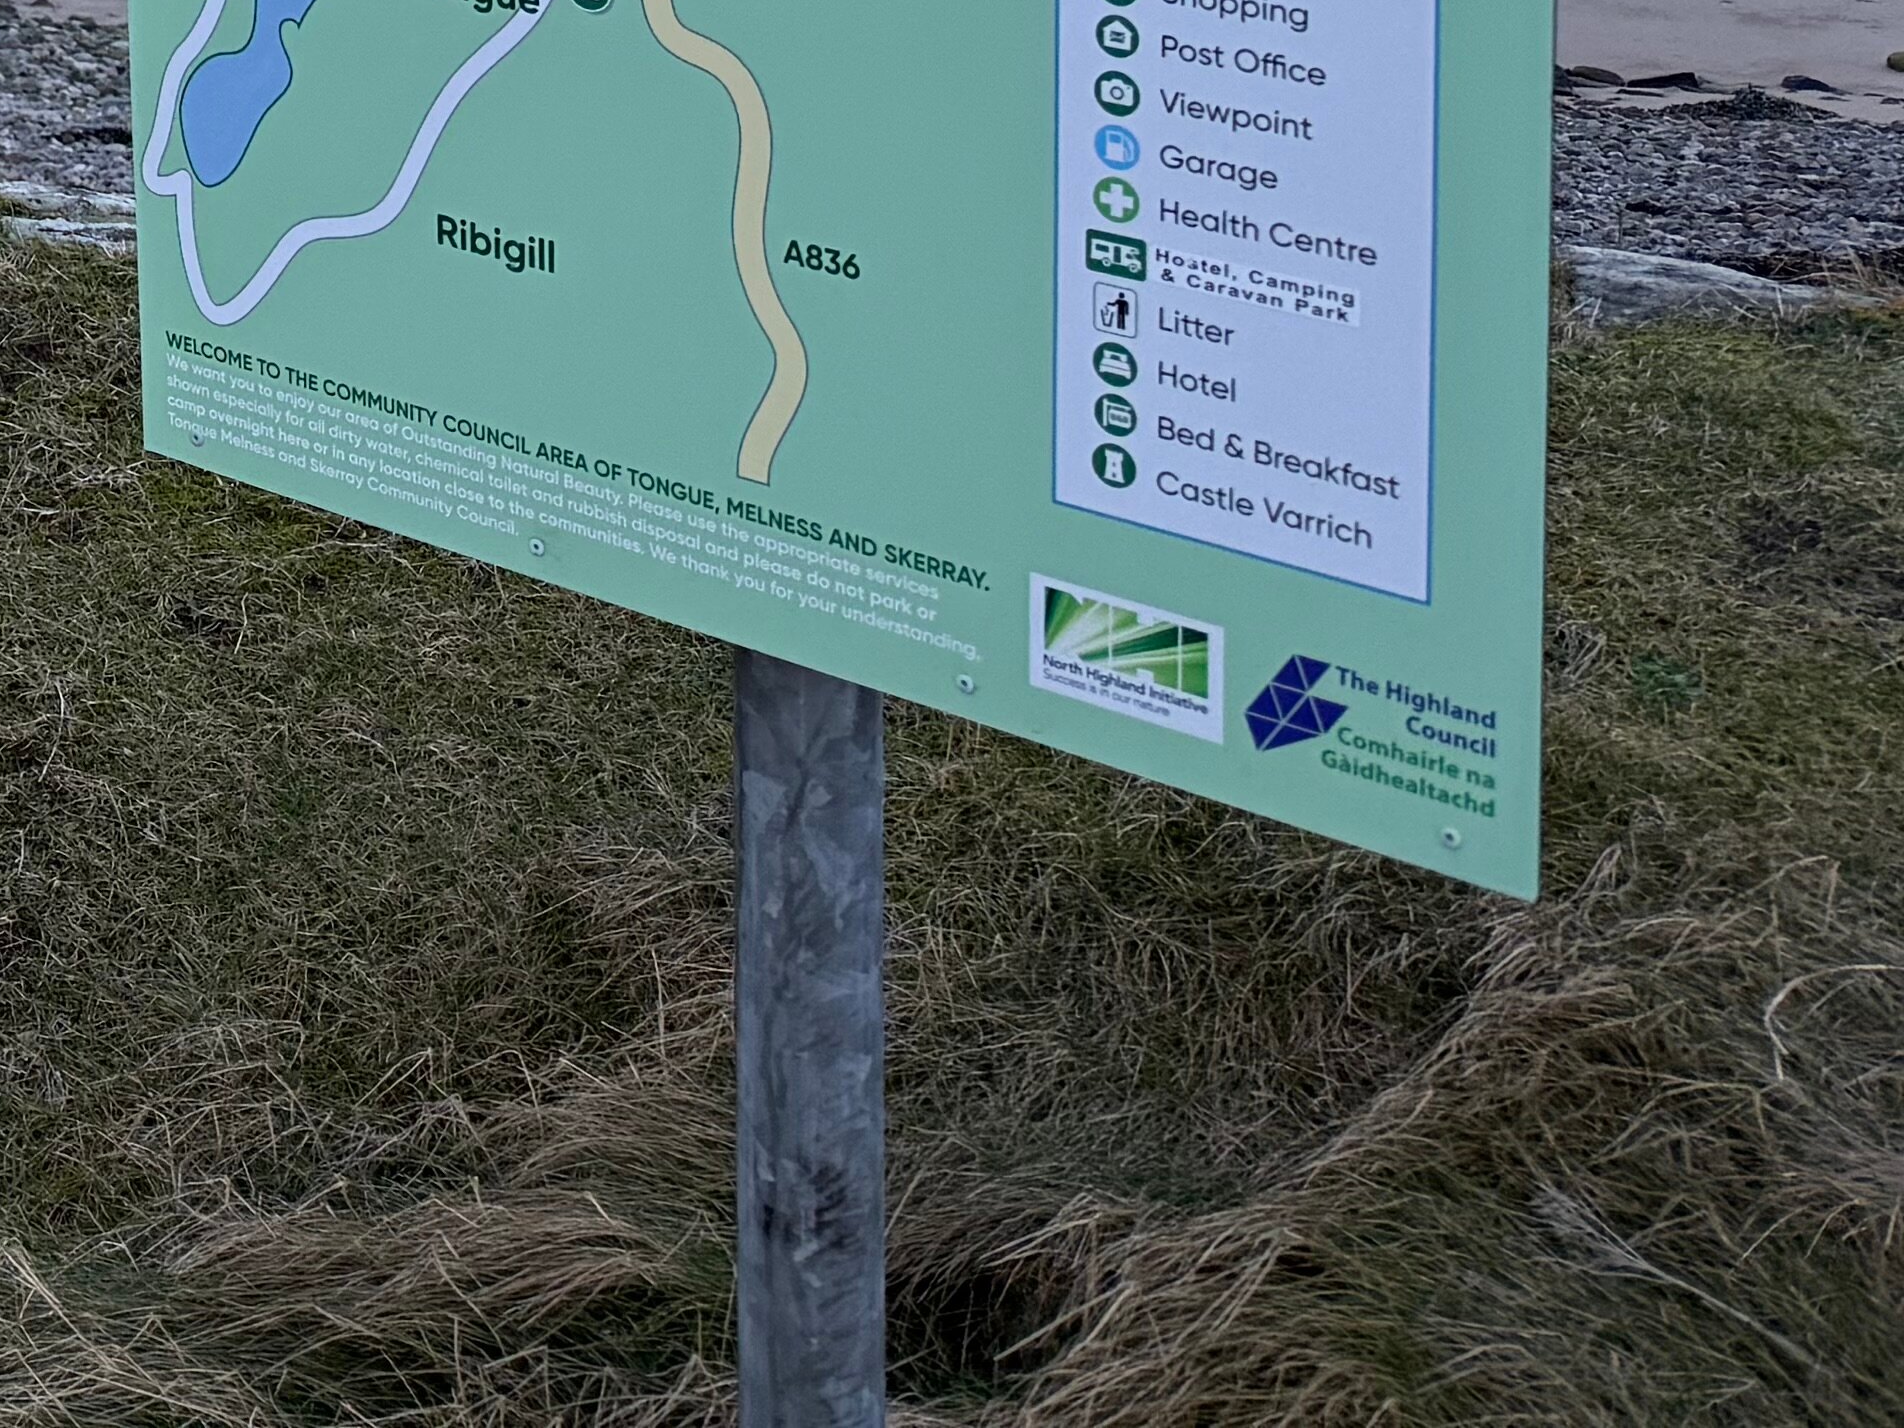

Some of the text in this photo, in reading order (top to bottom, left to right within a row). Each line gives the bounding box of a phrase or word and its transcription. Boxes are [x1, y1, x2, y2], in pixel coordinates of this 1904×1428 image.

[1160, 35, 1327, 86] Post Office
[1159, 89, 1313, 141] Viewpoint
[1159, 145, 1278, 192] Garage
[436, 213, 556, 274] Ribigill
[783, 239, 861, 280] A836
[1159, 198, 1378, 266] Health Centre
[1161, 268, 1349, 322] & Caravan Park
[1249, 270, 1354, 308] Camping
[1158, 307, 1234, 345] Litter
[1158, 361, 1236, 402] Hotel
[166, 330, 990, 591] WELCOME TO THE COMMUNITY COUNCIL AREA OF TONGUE, MELNESS AND SKERRAY.
[166, 353, 939, 599] We want you to enjoy our area of Outstanding Natural Beauty. Please use the appropriate services
[221, 429, 274, 458] Melness
[279, 451, 306, 468] and
[310, 458, 363, 489] Skerray
[368, 477, 452, 517] Community
[457, 505, 519, 536] Council.
[1157, 416, 1400, 499] Bed & Breakfast
[167, 375, 937, 621] shown especially for all dirty water, chemical toilet and rubbish disposal and please do not park or
[168, 396, 206, 417] camp
[209, 409, 274, 439] overnight
[279, 429, 309, 449] here
[313, 442, 328, 455] or
[333, 445, 344, 461] in
[349, 453, 375, 472] any
[380, 459, 440, 491] location
[445, 481, 484, 504] close
[488, 495, 504, 510] to
[509, 501, 534, 519] the
[539, 513, 644, 554] communities.
[649, 543, 677, 564] We
[681, 555, 730, 581] thank
[734, 573, 765, 592] you
[770, 581, 793, 600] for
[798, 592, 837, 613] your
[1156, 471, 1372, 549] Castle Varrich
[1043, 654, 1209, 714] North Highland Initiative
[1335, 665, 1496, 729] The Highland
[1337, 727, 1495, 789] Comhairle na
[1406, 716, 1495, 758] Council
[1321, 749, 1495, 817] Gàidhealtachd
